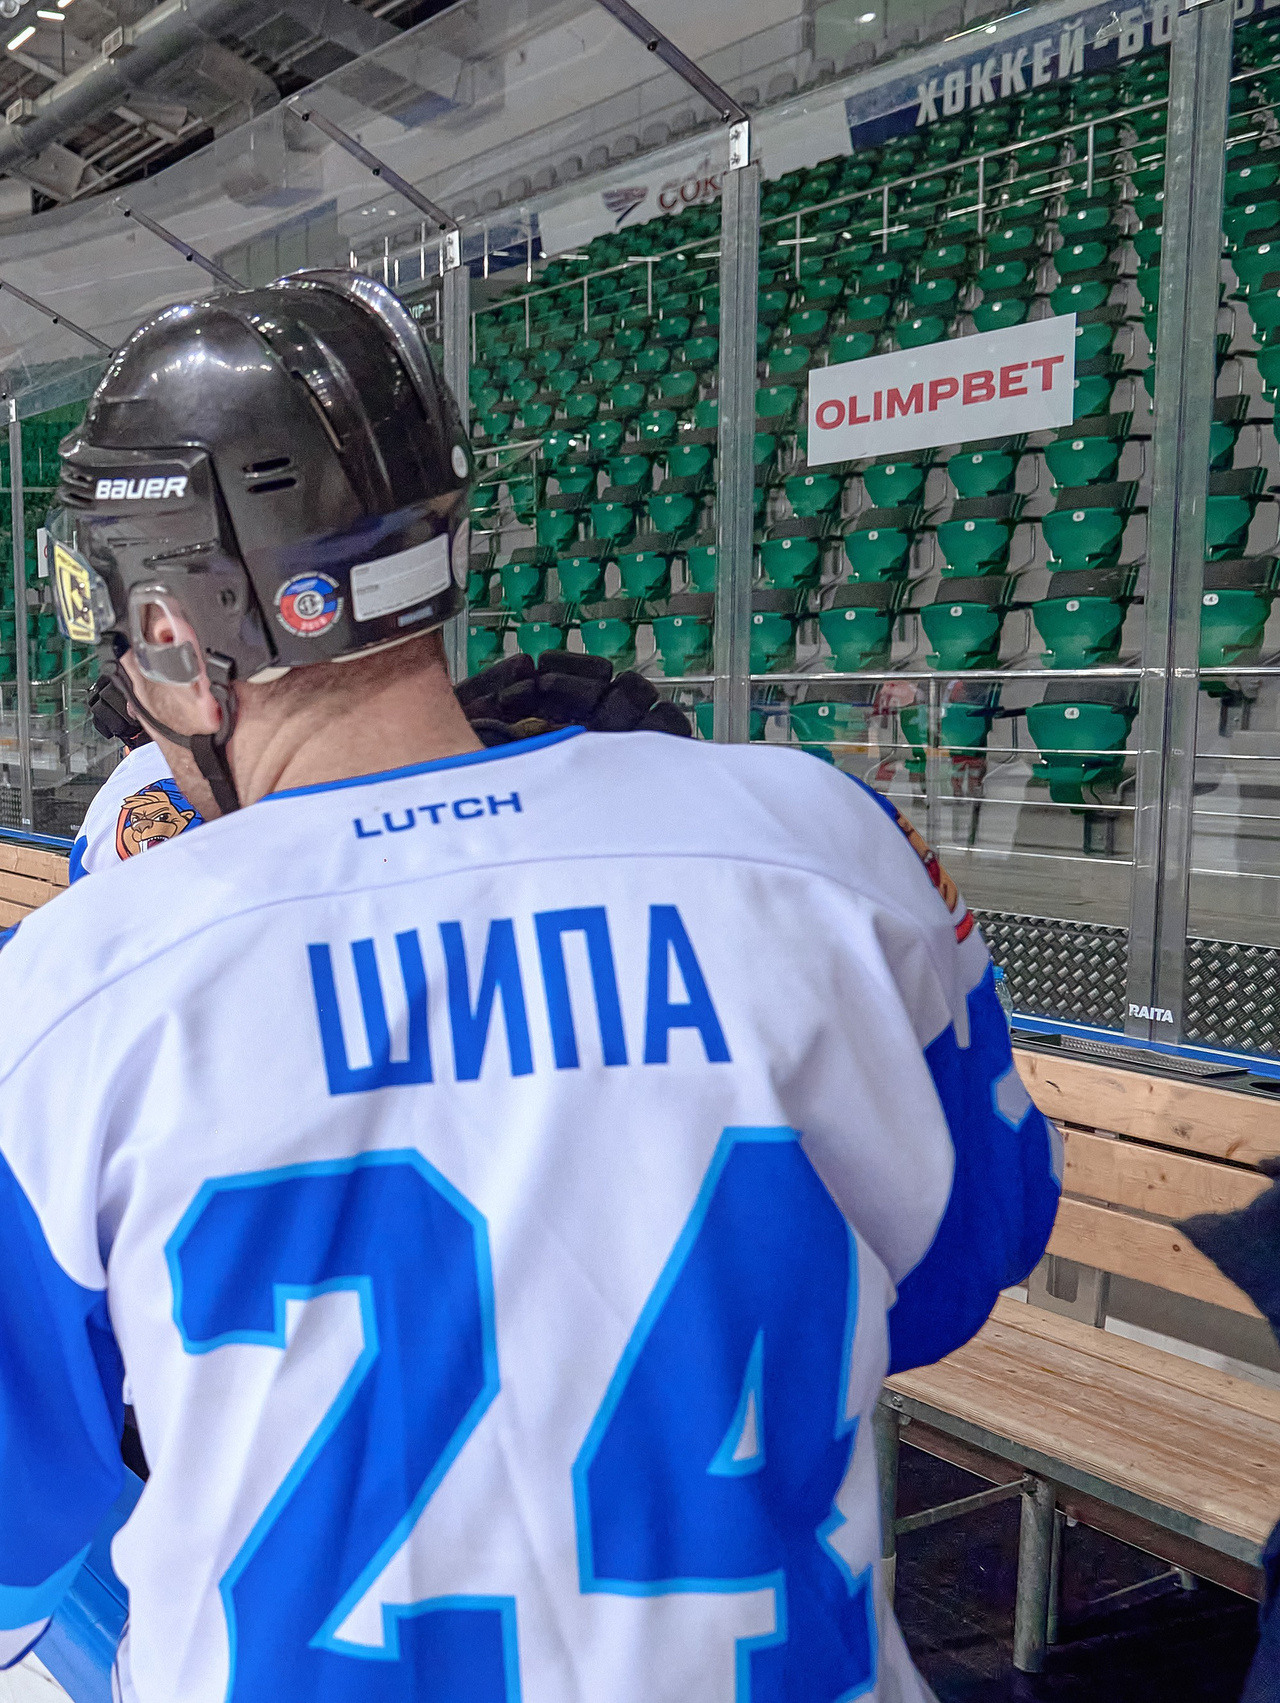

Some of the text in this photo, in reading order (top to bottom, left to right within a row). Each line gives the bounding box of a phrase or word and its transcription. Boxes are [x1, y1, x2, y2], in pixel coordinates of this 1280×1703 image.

[915, 18, 1086, 127] ХОККЕЙ
[815, 355, 1065, 430] OLIMPBET
[95, 476, 188, 500] BAUER
[353, 792, 522, 839] LUTCH
[306, 904, 732, 1095] ШИПА
[1128, 1003, 1174, 1024] RAITA
[164, 1126, 877, 1703] 24
